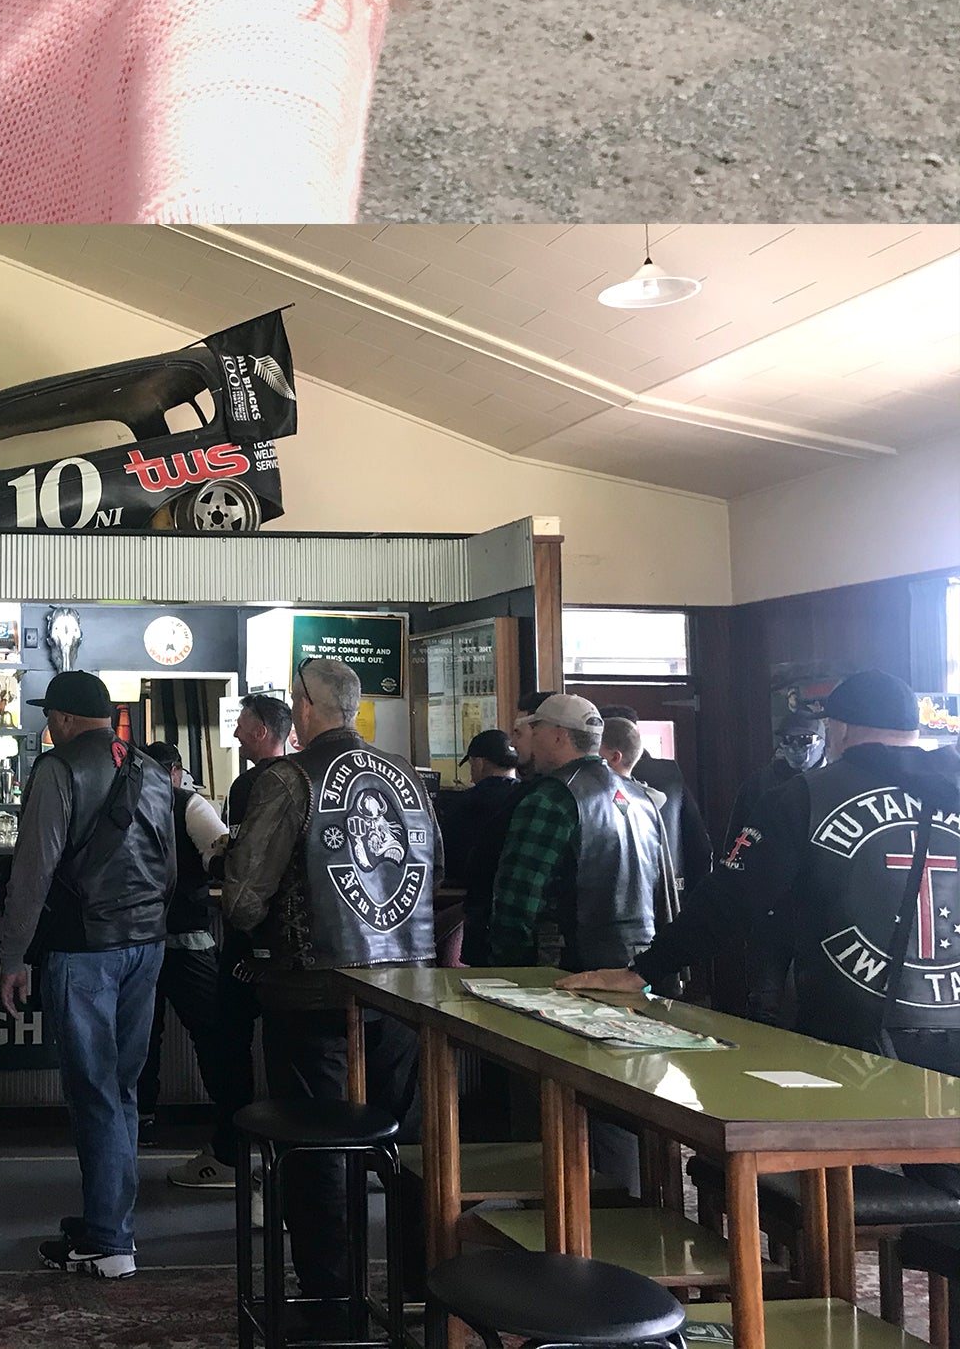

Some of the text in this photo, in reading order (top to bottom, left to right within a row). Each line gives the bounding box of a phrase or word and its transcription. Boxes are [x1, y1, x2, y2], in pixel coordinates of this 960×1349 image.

[221, 355, 241, 387] 100
[236, 355, 248, 375] ALL
[242, 377, 262, 421] BLACKS
[7, 457, 124, 529] 10 NI
[339, 637, 371, 645] SUMMER.
[323, 752, 415, 806] Iron Thunder
[819, 812, 864, 849] TU
[339, 870, 420, 927] New Zealand
